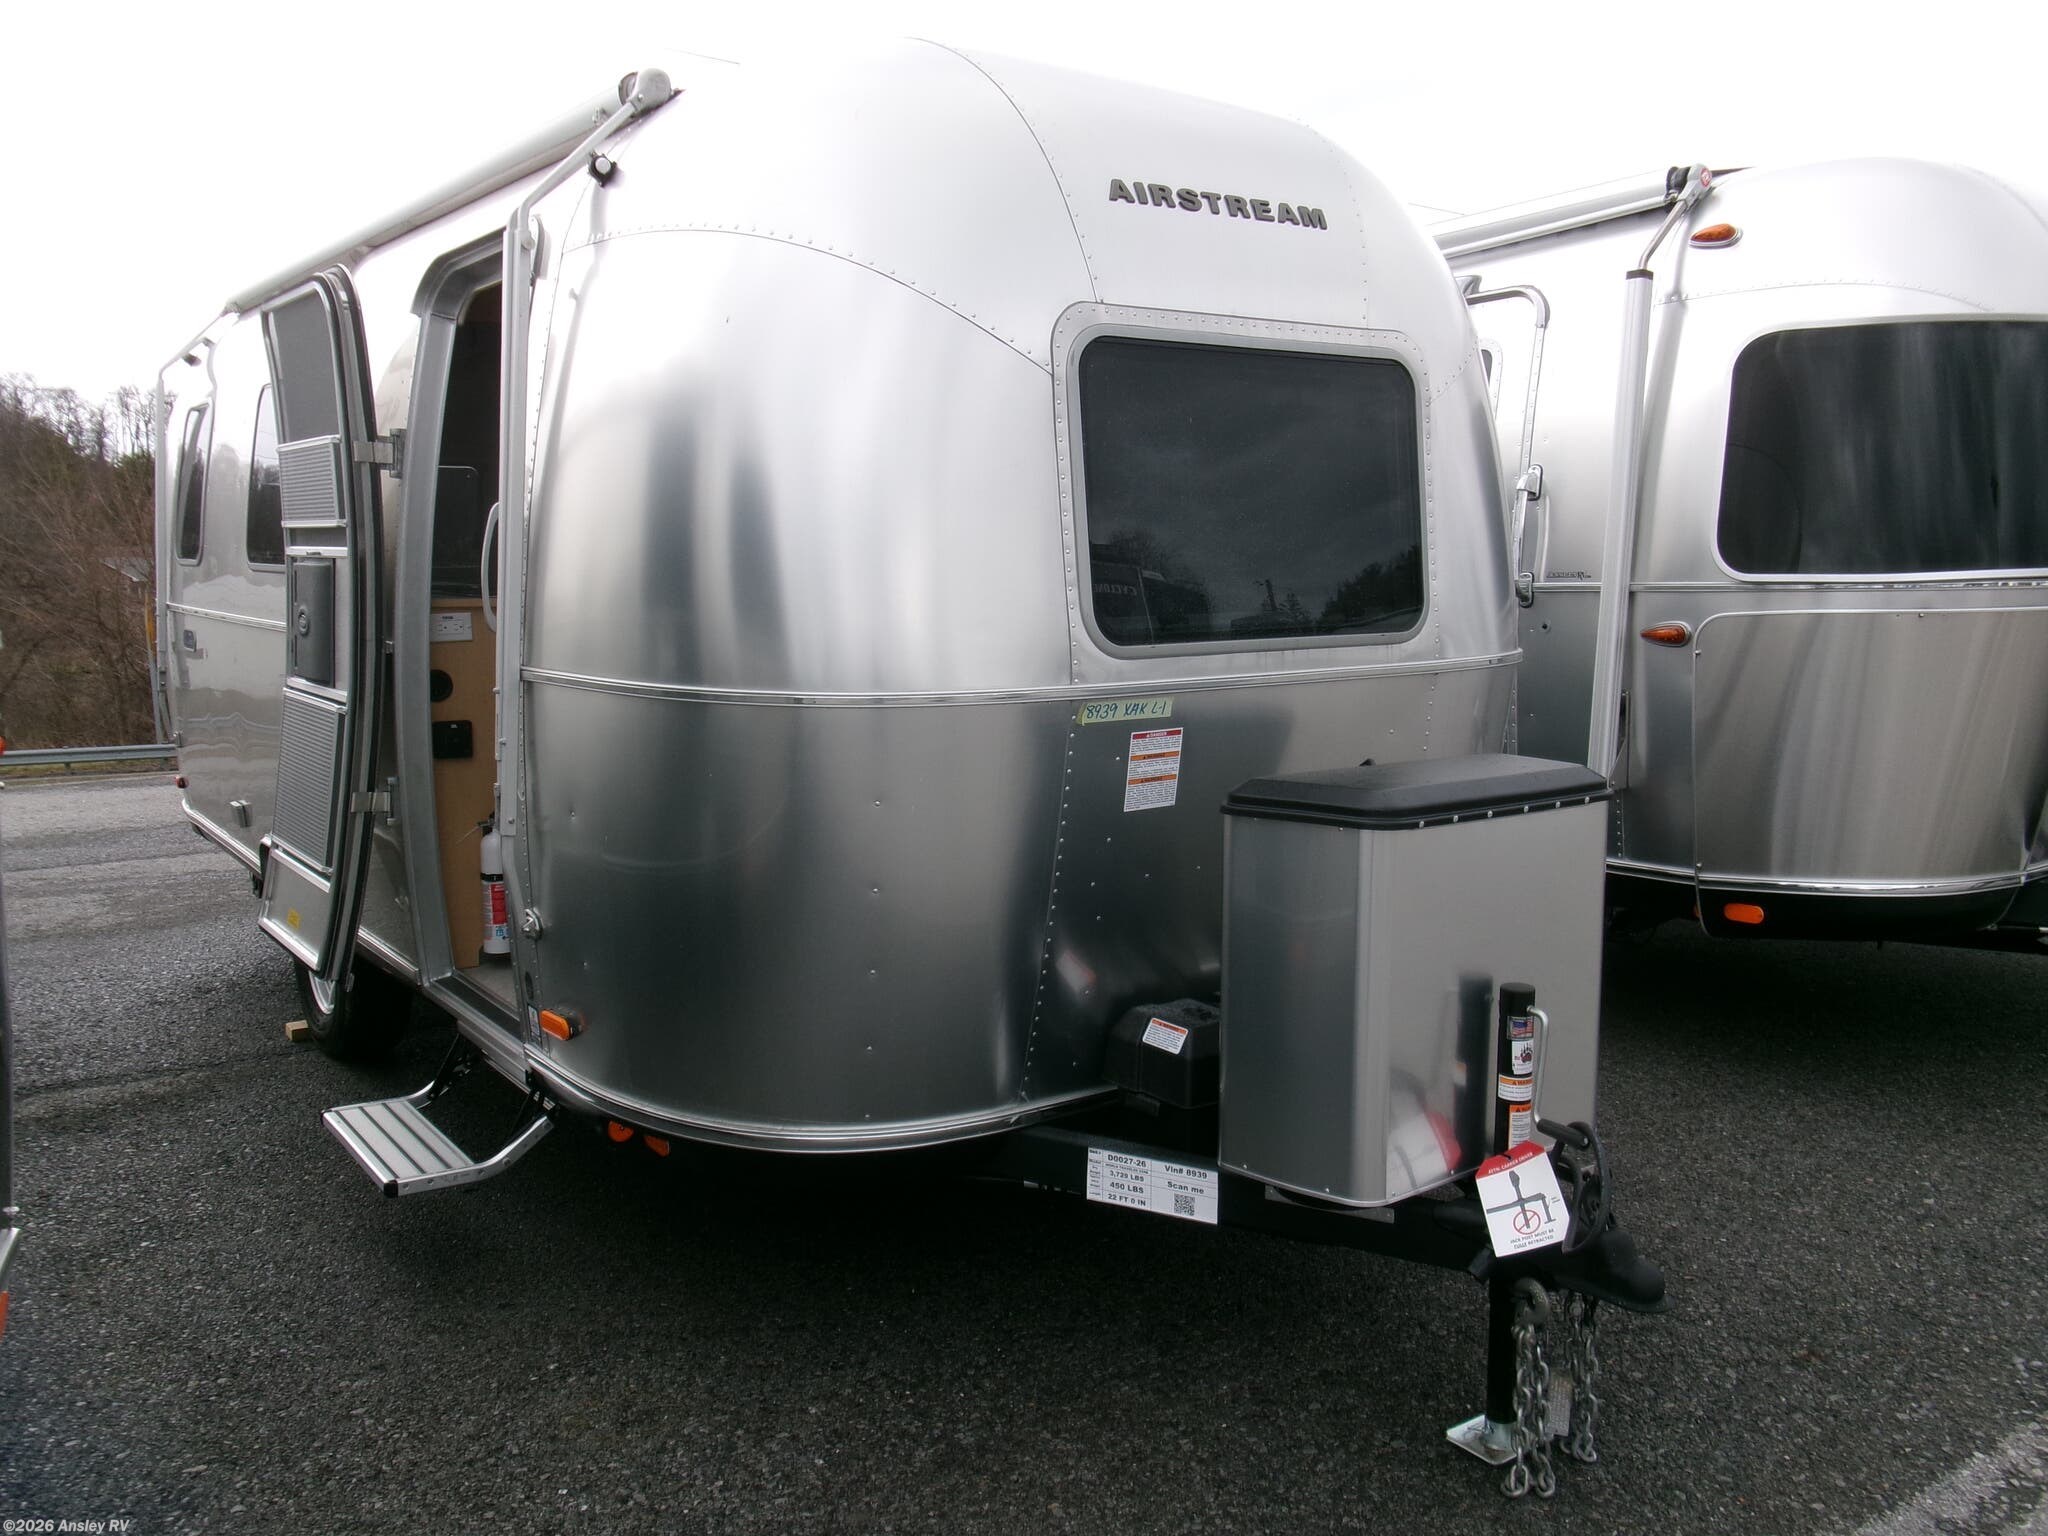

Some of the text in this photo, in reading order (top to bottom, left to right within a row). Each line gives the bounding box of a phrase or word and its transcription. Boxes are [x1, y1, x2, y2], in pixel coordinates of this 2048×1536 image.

[1108, 178, 1328, 231] AIRSTREAM
[1086, 702, 1118, 719] 8939
[1107, 1154, 1147, 1168] D0027-26
[1130, 1174, 1145, 1182] LBS
[1186, 1169, 1208, 1179] 8939
[1110, 1182, 1144, 1194] 450 LBS
[1167, 1181, 1189, 1191] Scan
